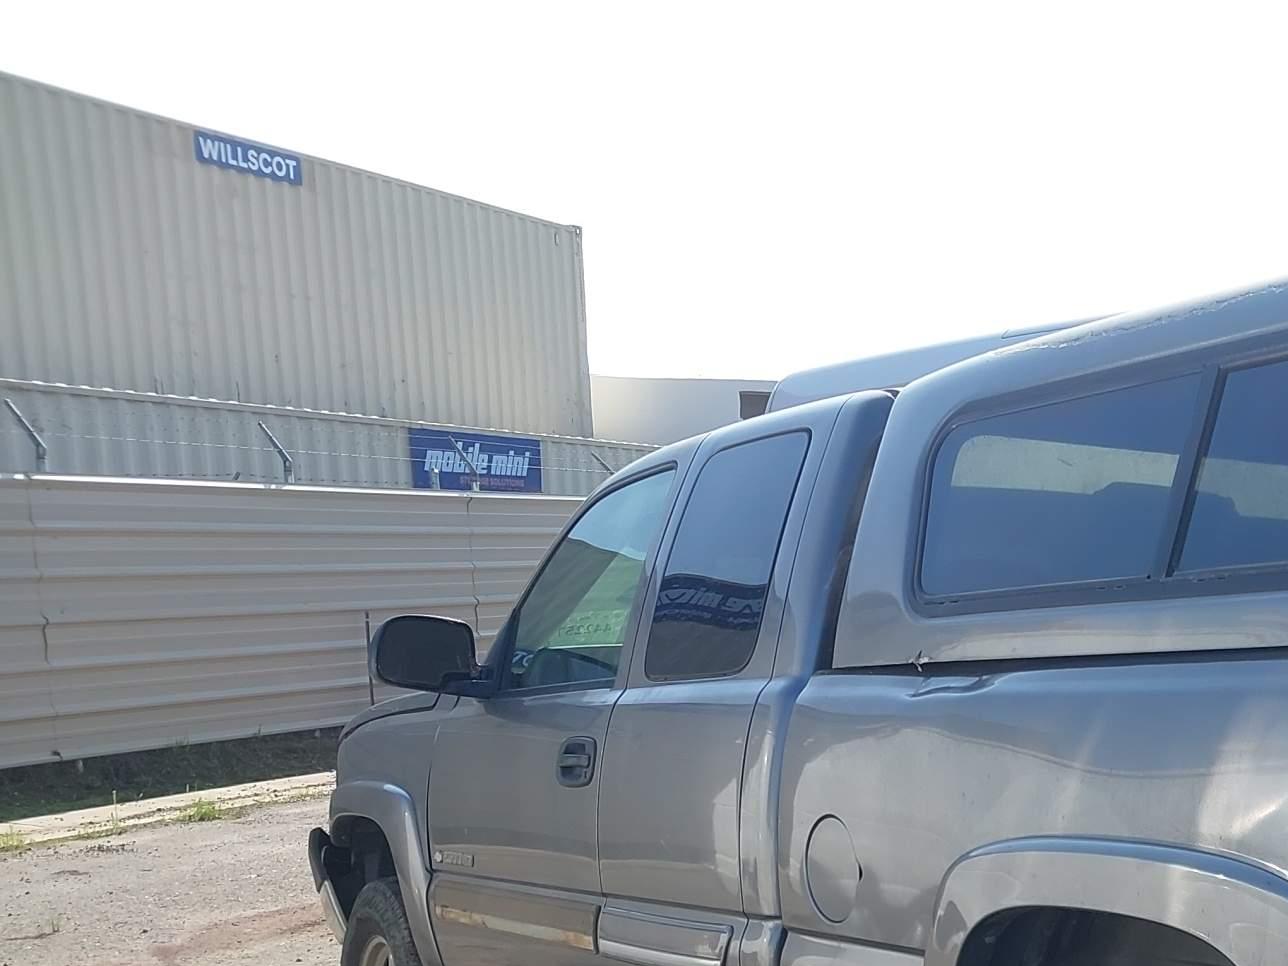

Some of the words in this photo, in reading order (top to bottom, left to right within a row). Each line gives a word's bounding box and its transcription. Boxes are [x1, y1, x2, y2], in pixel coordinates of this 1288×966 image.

[198, 136, 297, 180] WILLSCOT
[424, 441, 489, 474] mobile
[490, 450, 531, 477] mini
